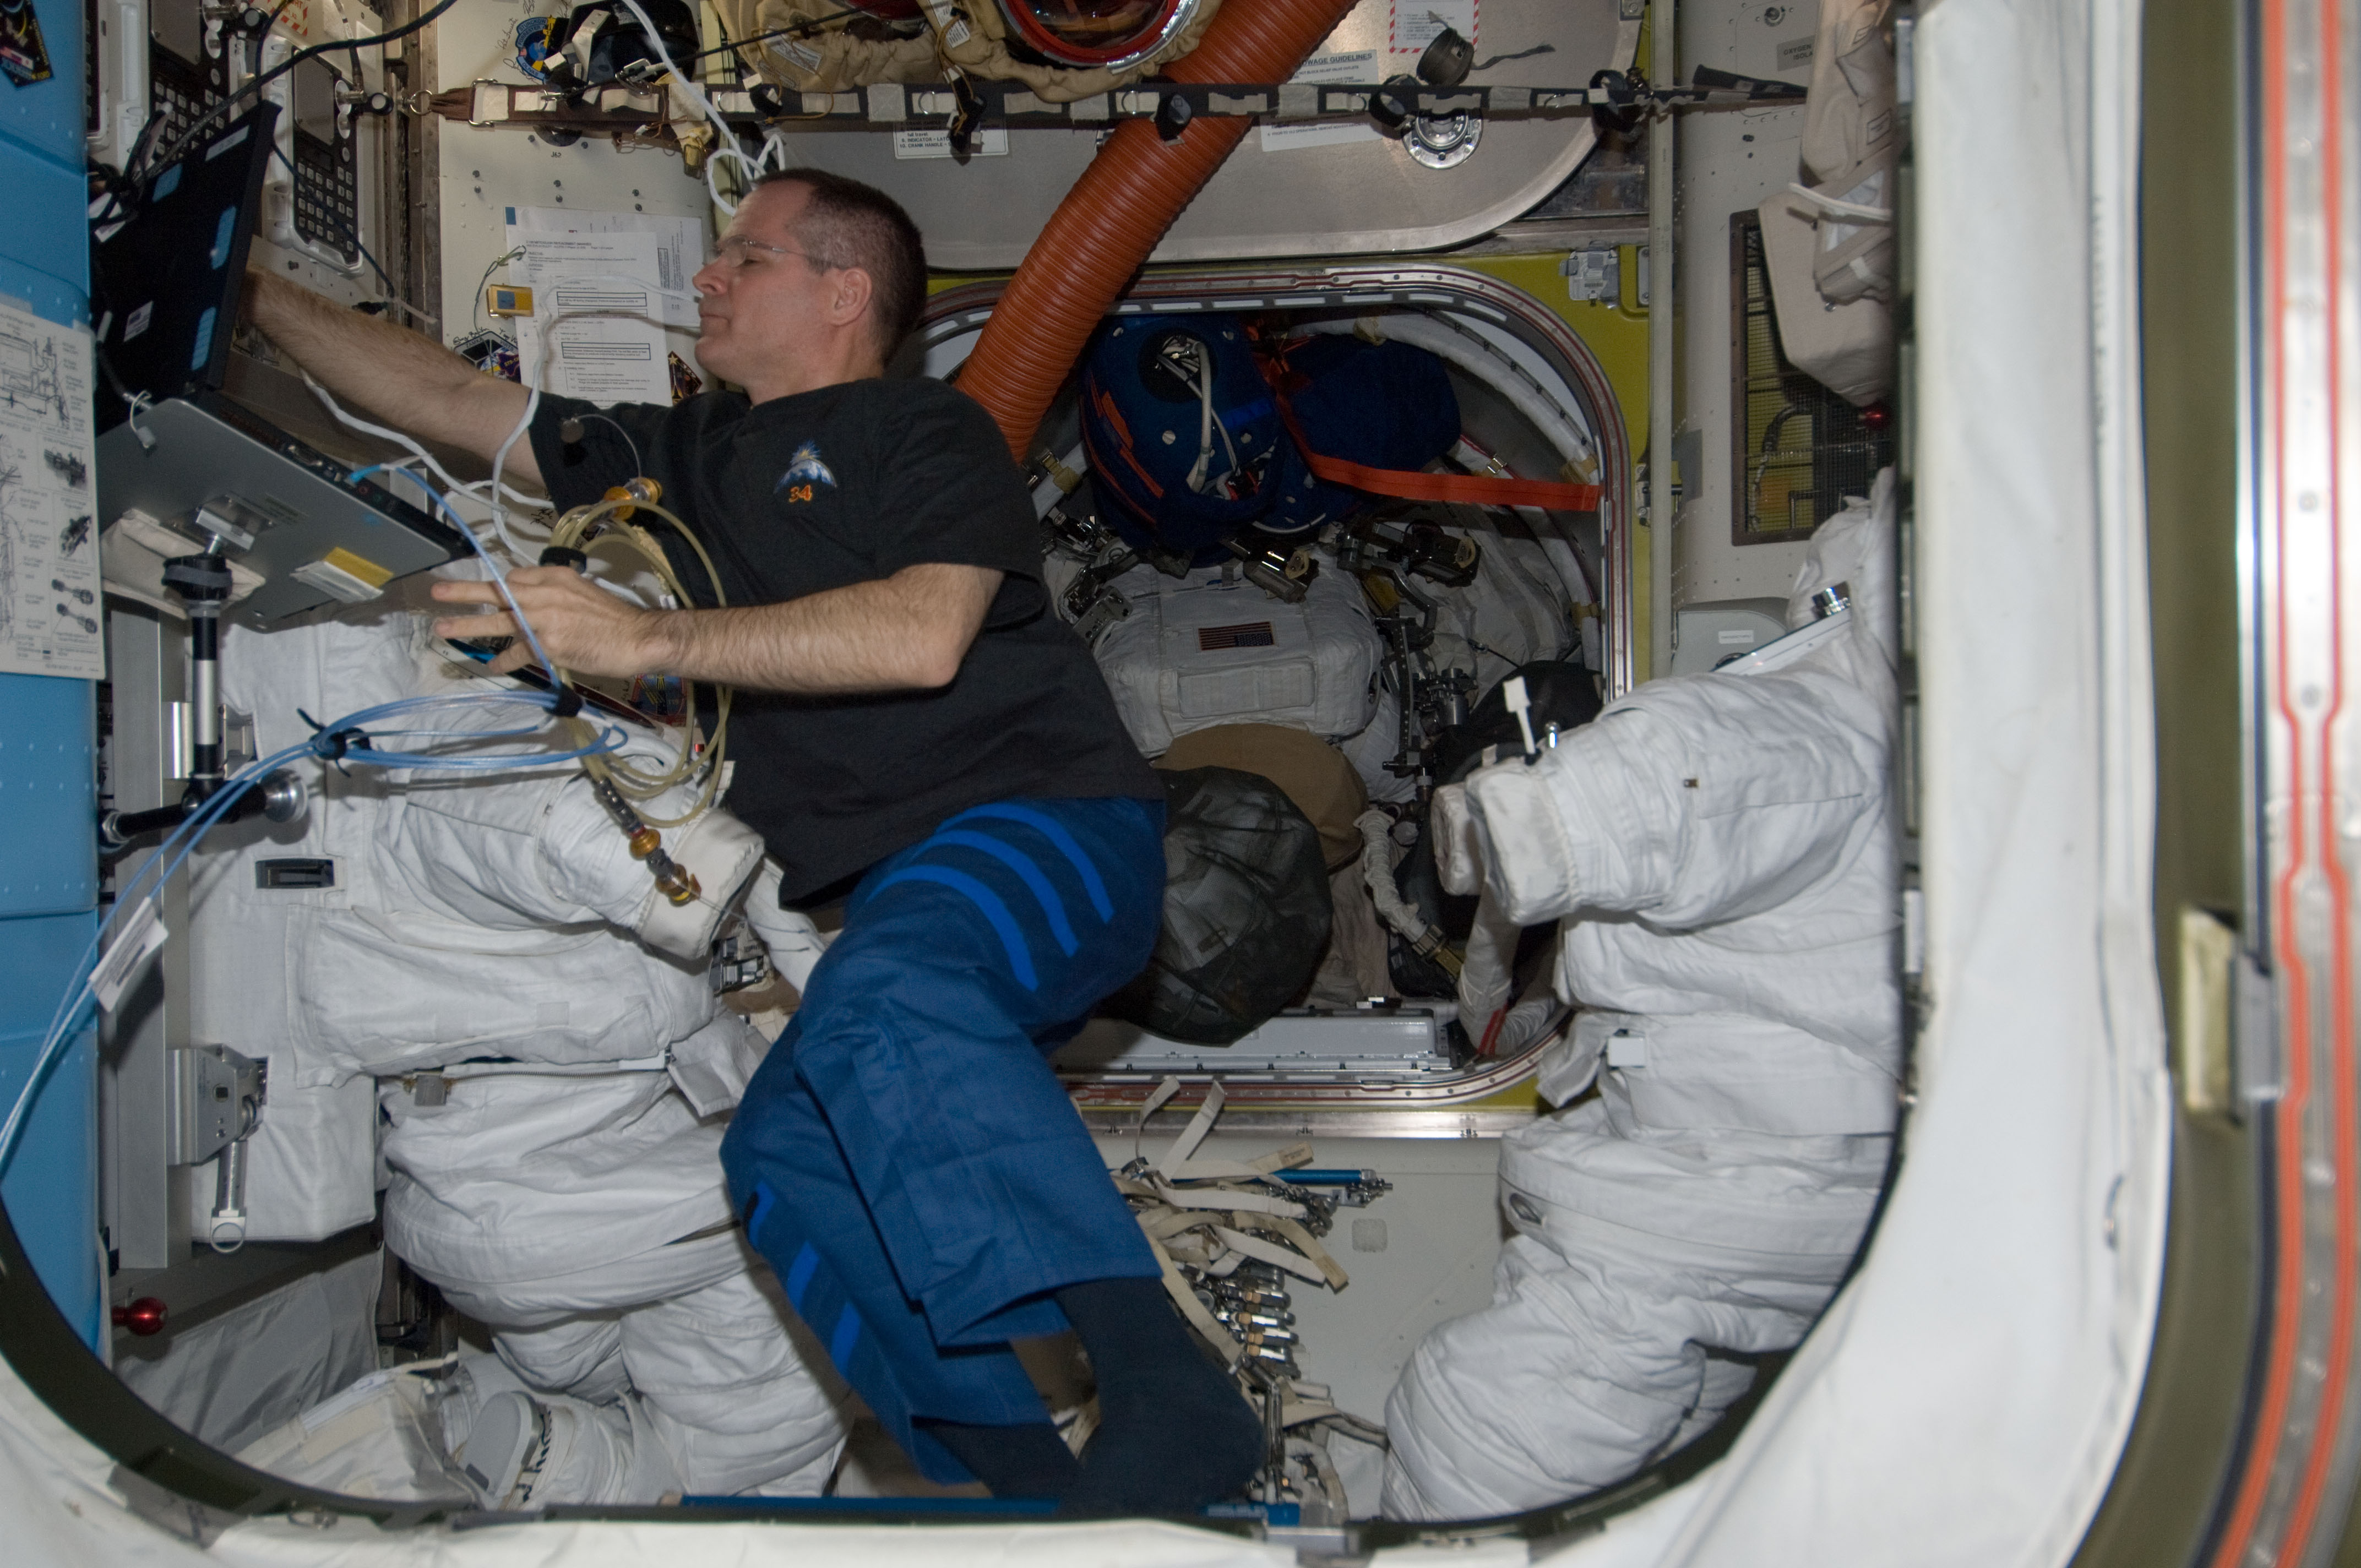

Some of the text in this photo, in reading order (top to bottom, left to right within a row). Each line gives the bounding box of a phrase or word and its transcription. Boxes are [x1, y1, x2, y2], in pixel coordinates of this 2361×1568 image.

[519, 19, 546, 32] STURCKOW
[518, 26, 540, 45] FORRESTER
[1784, 45, 1811, 55] OXYGEN
[1793, 52, 1813, 60] ISOLA
[1303, 53, 1372, 66] OWAGE GUIDELINES
[523, 62, 538, 77] OLIVAS
[466, 337, 483, 349] ZAMKA
[500, 340, 514, 351] VIRTS
[504, 357, 519, 367] STS-13
[788, 484, 812, 503] 34
